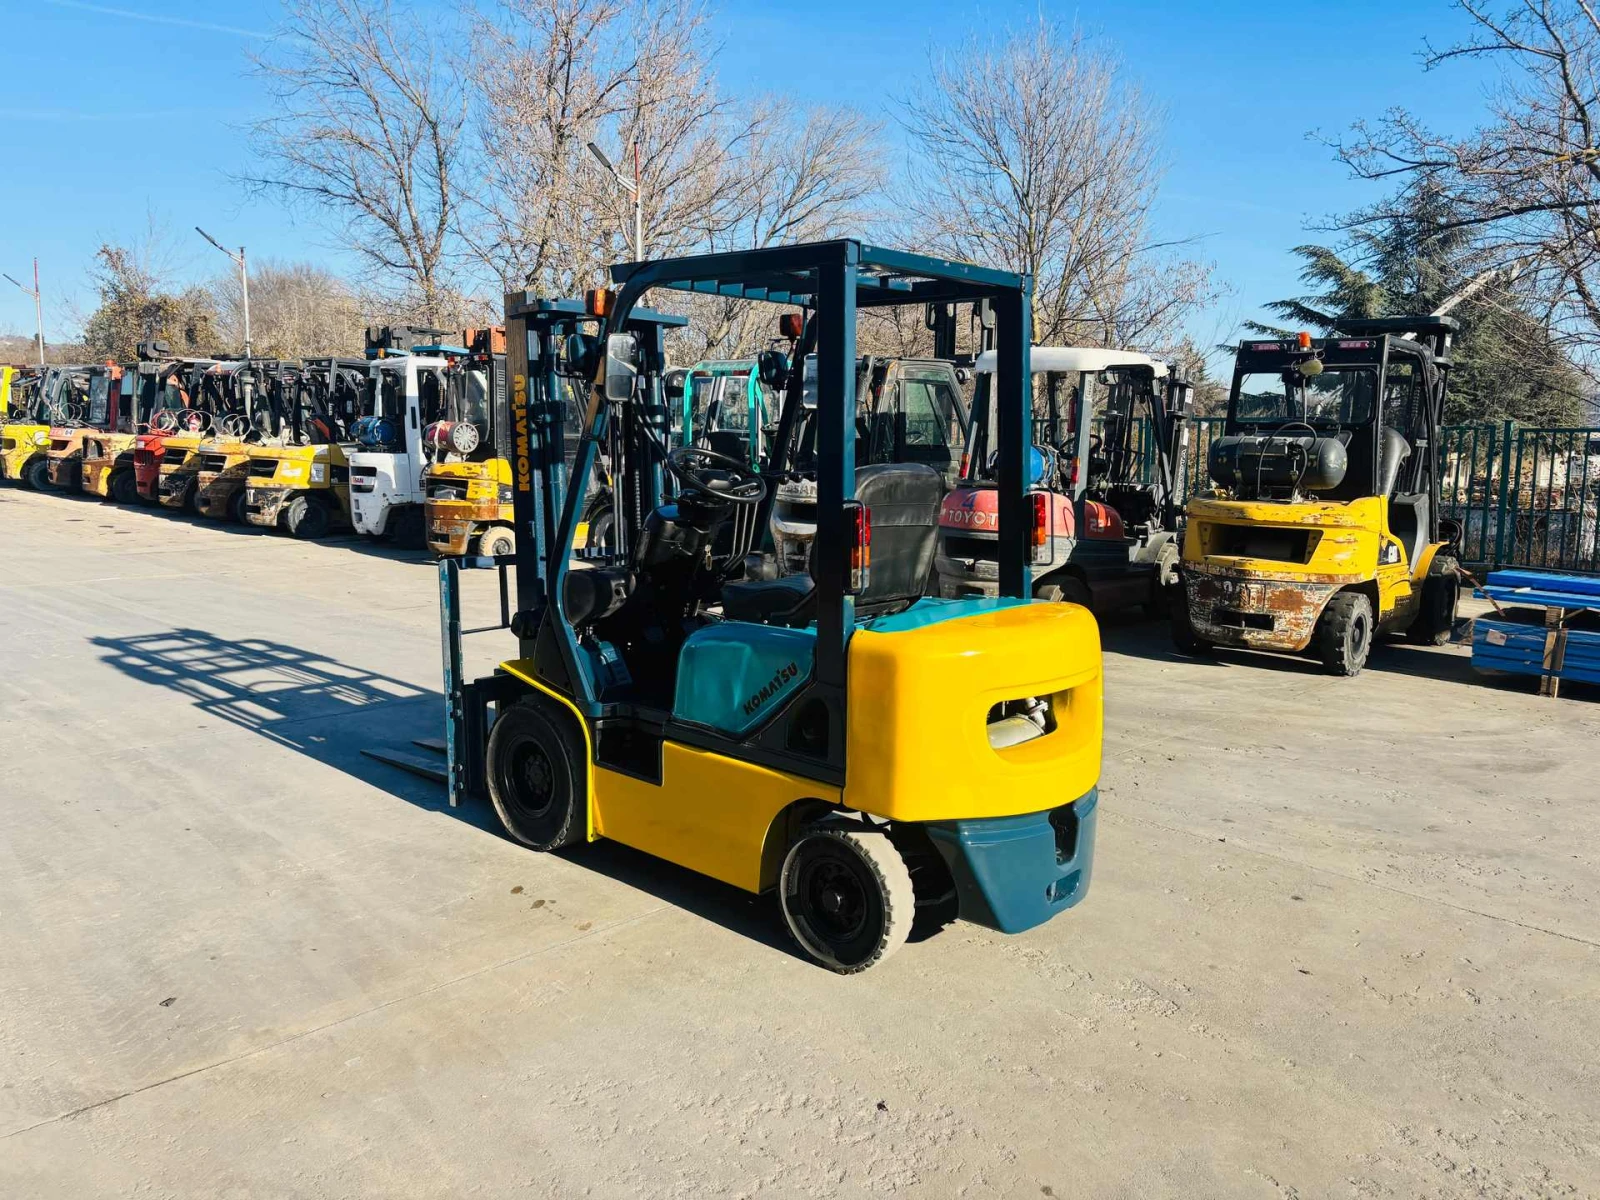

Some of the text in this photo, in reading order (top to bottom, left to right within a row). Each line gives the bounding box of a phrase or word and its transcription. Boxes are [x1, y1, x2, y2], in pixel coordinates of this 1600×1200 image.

[512, 374, 530, 491] KOMATSU
[948, 509, 998, 527] TOYOT
[743, 662, 798, 716] KOMATSU
